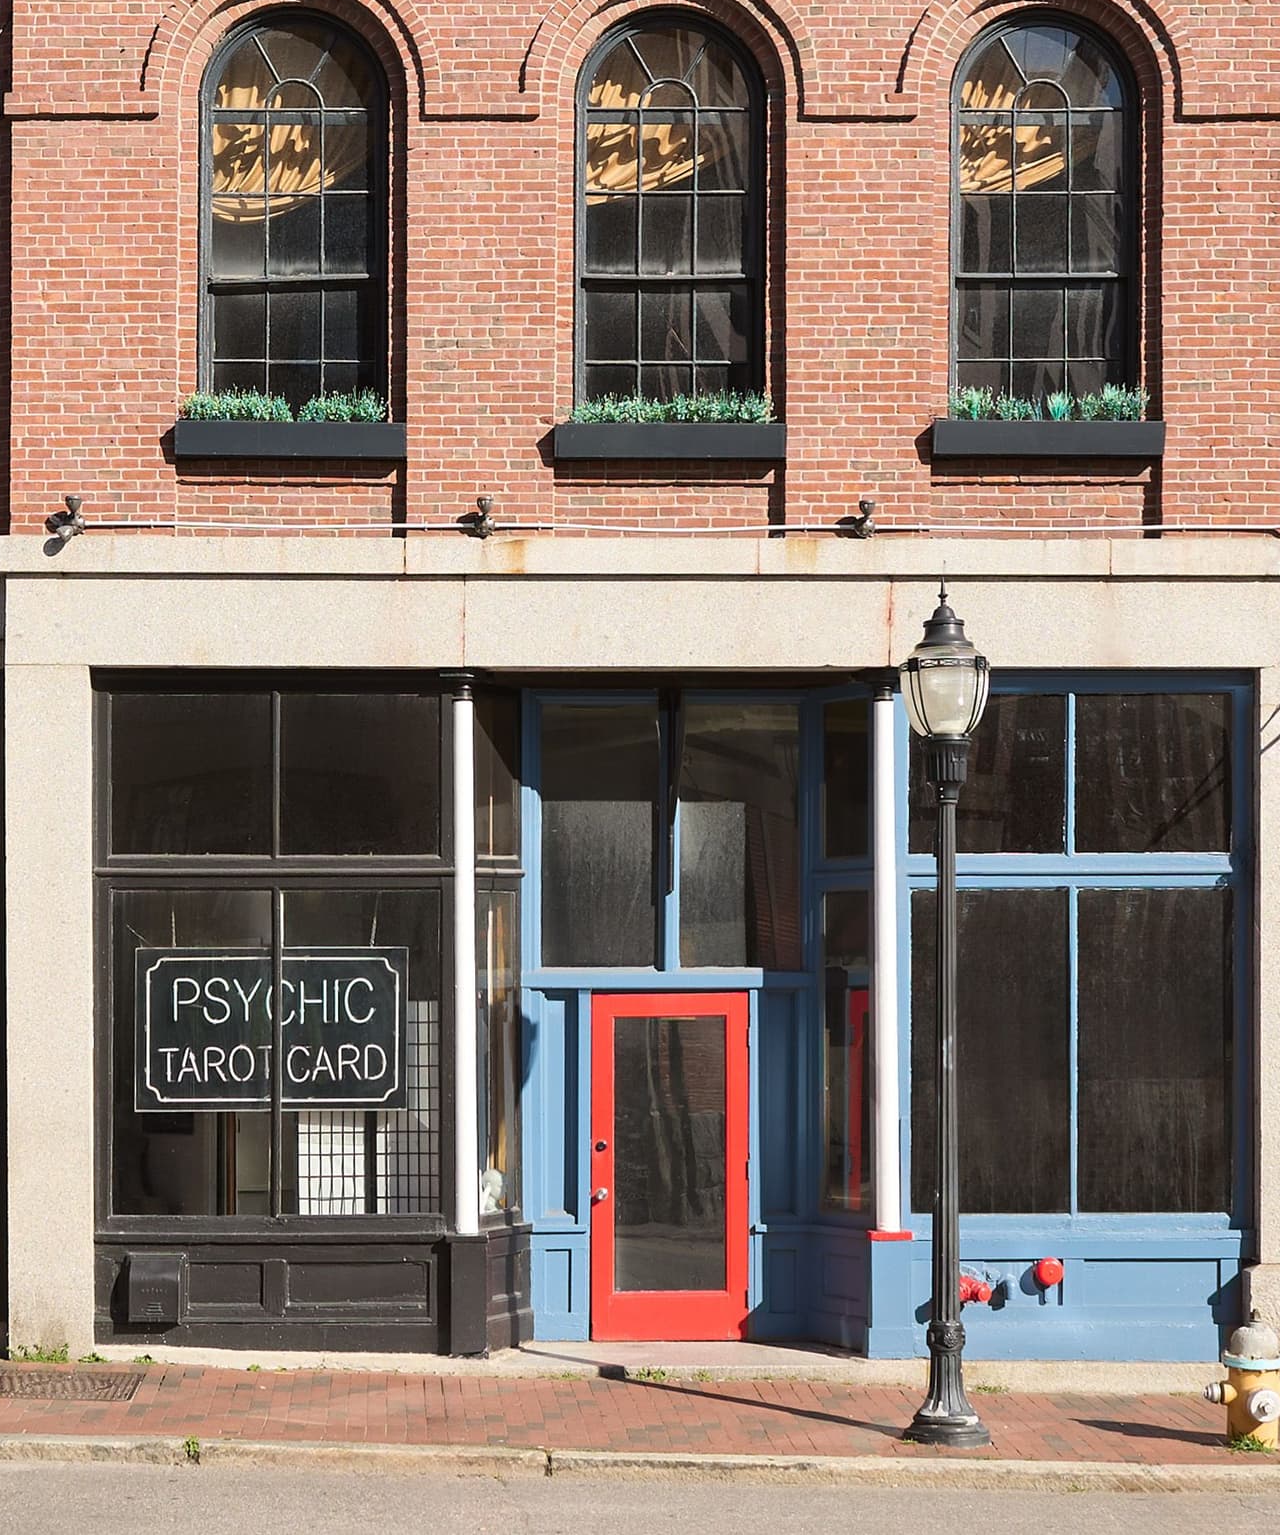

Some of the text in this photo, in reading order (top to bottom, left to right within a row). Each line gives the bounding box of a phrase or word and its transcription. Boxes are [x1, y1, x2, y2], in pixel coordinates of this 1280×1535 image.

[173, 977, 376, 1025] PSYCHIC
[158, 1044, 387, 1083] TAROT CARD
